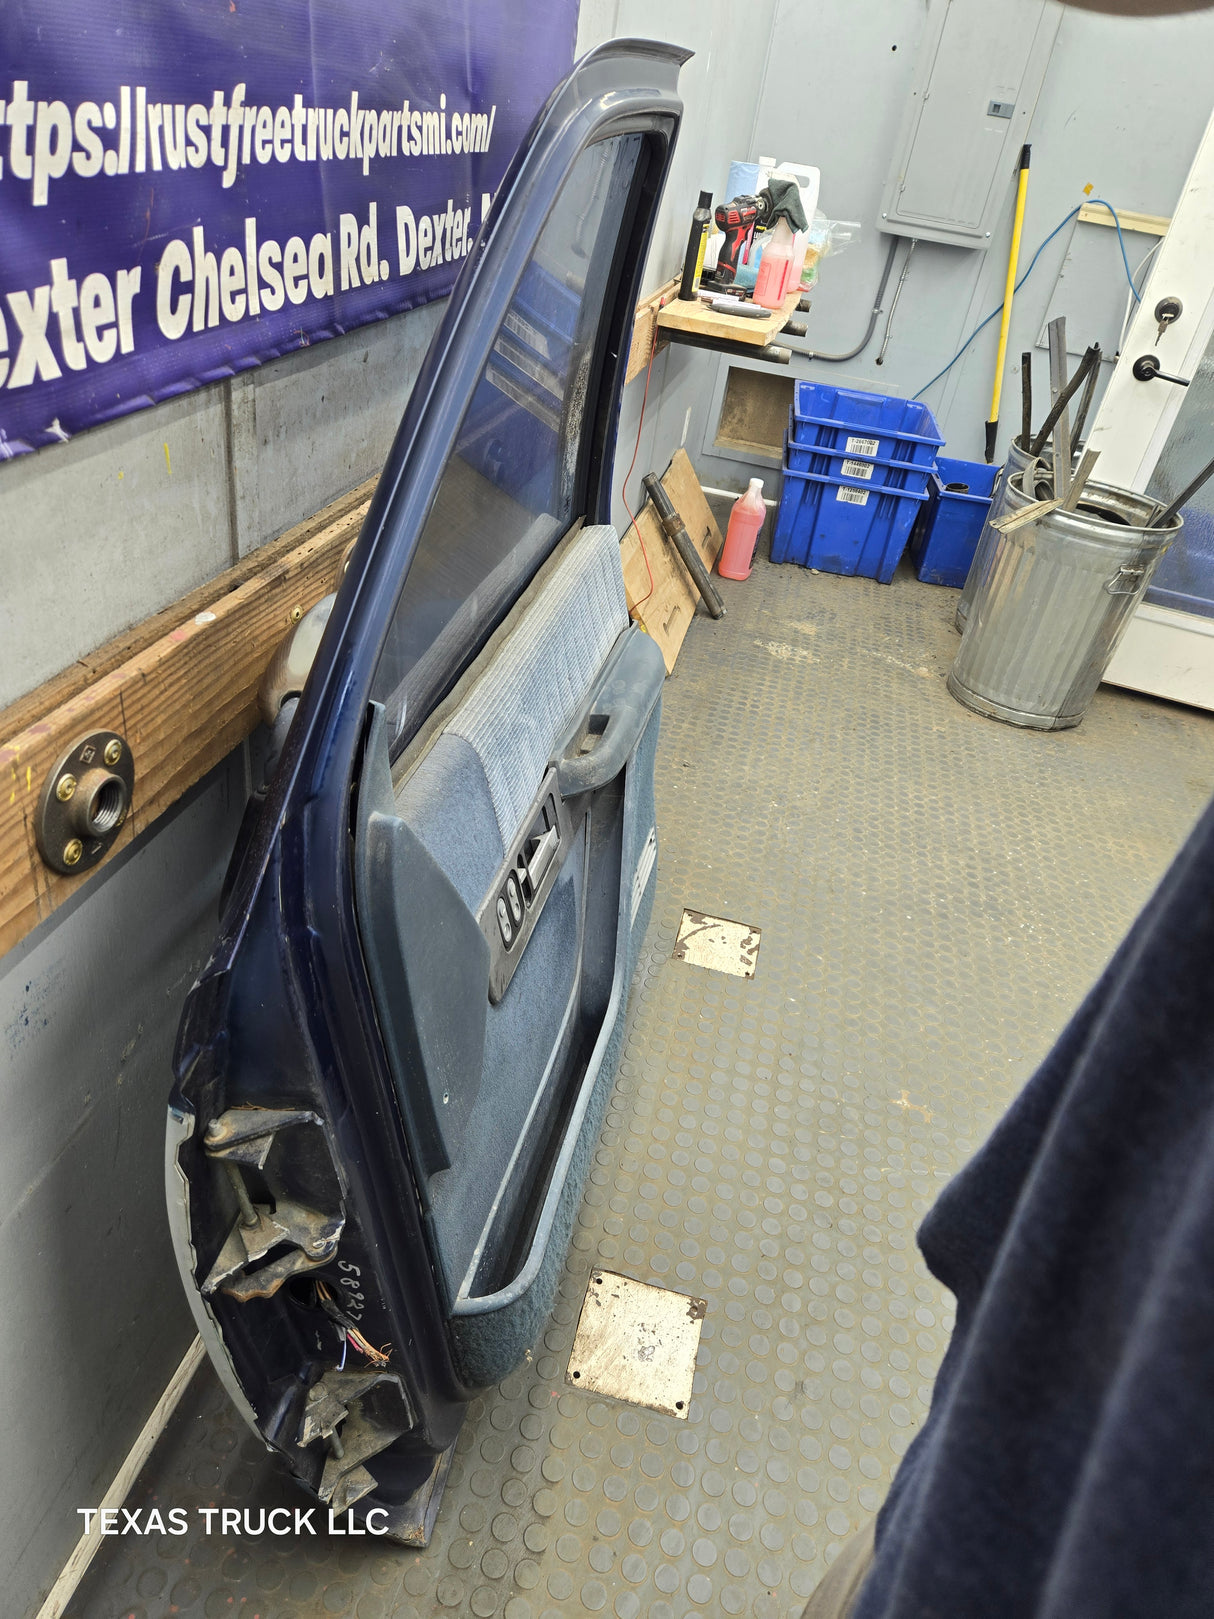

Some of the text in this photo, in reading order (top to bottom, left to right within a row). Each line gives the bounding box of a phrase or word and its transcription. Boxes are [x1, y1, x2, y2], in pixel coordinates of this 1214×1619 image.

[0, 79, 497, 207] tps://rustfreetruckpartsmi.com/
[0, 256, 141, 390] xter
[156, 217, 335, 341] Chelsea
[339, 201, 390, 292] Rd.
[337, 1259, 366, 1322] 58927
